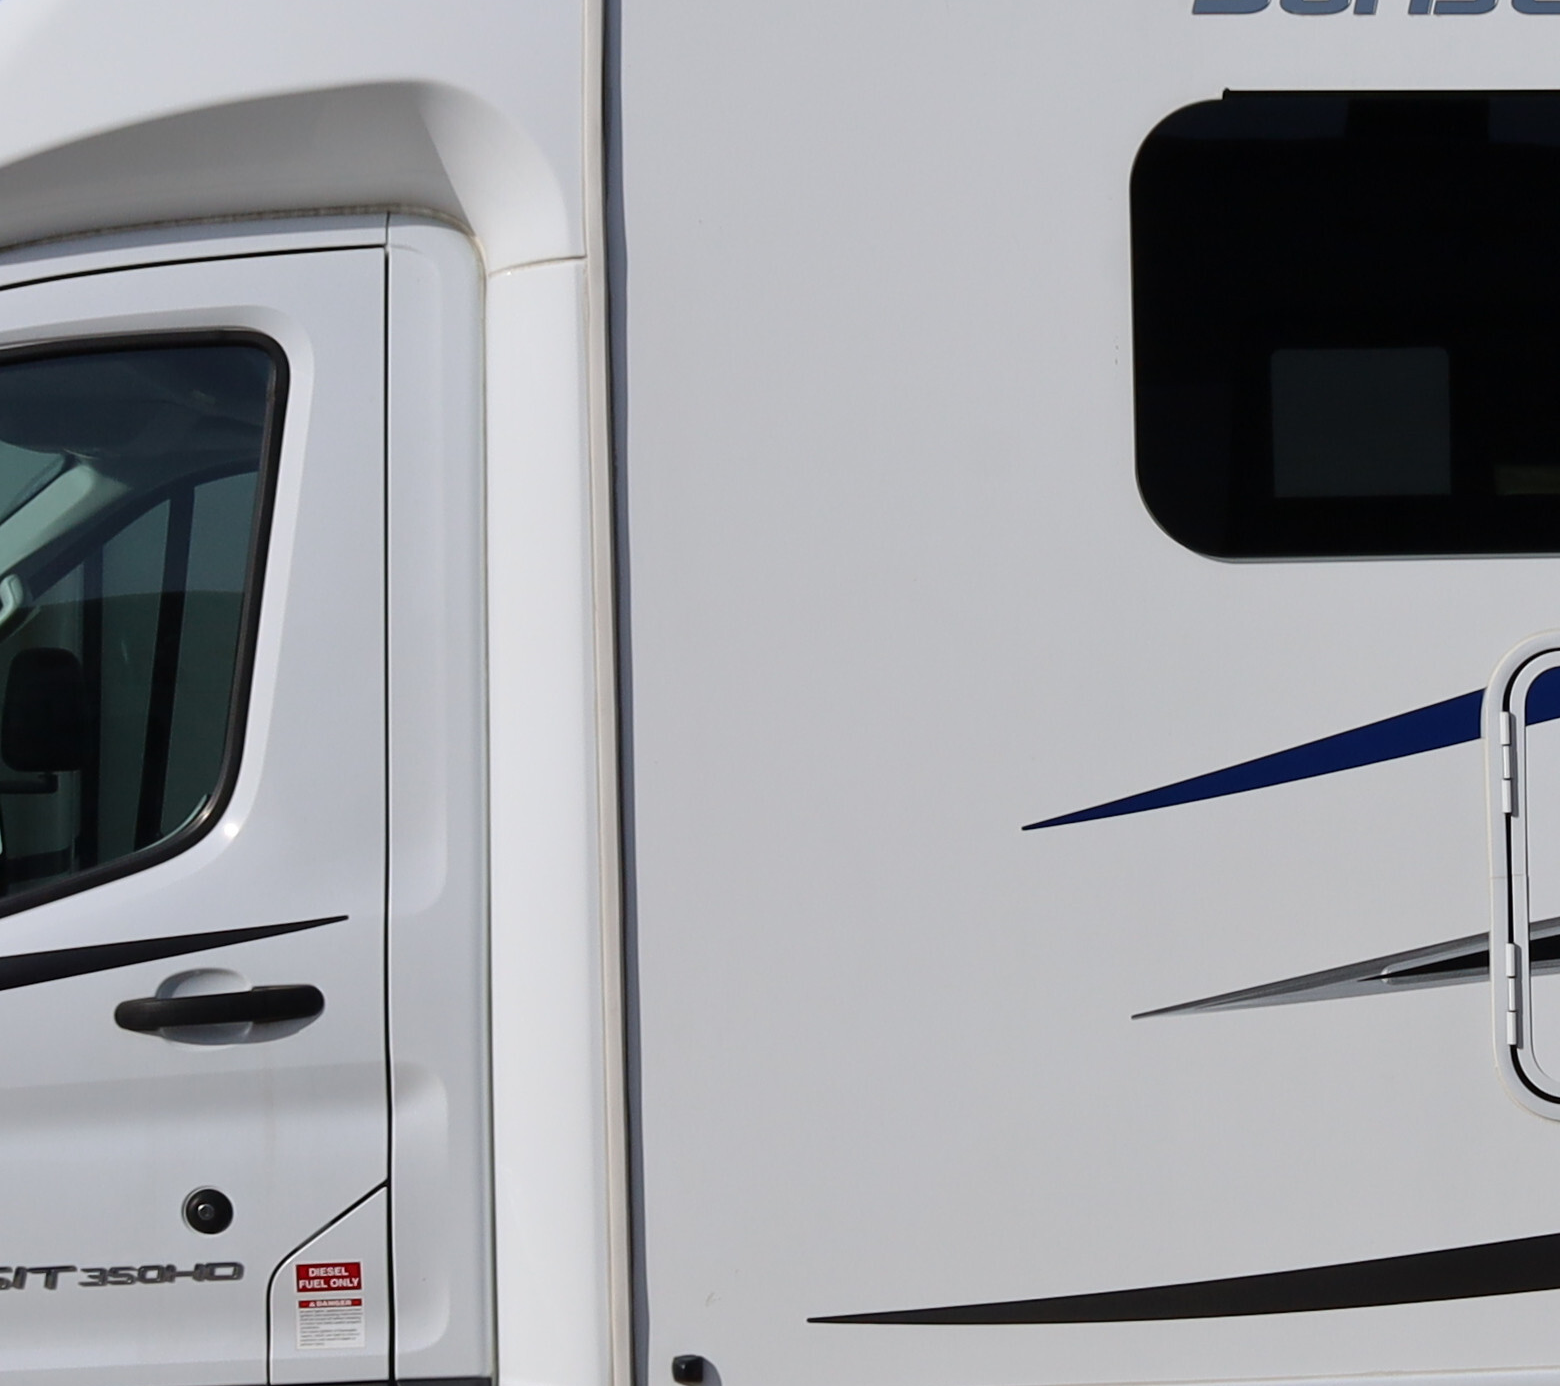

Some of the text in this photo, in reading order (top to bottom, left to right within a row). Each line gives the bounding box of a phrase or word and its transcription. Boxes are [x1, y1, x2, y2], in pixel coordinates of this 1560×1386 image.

[308, 1266, 349, 1277] DIESEL
[299, 1277, 359, 1289] FUEL ONLY
[316, 1299, 352, 1307] DANGER
